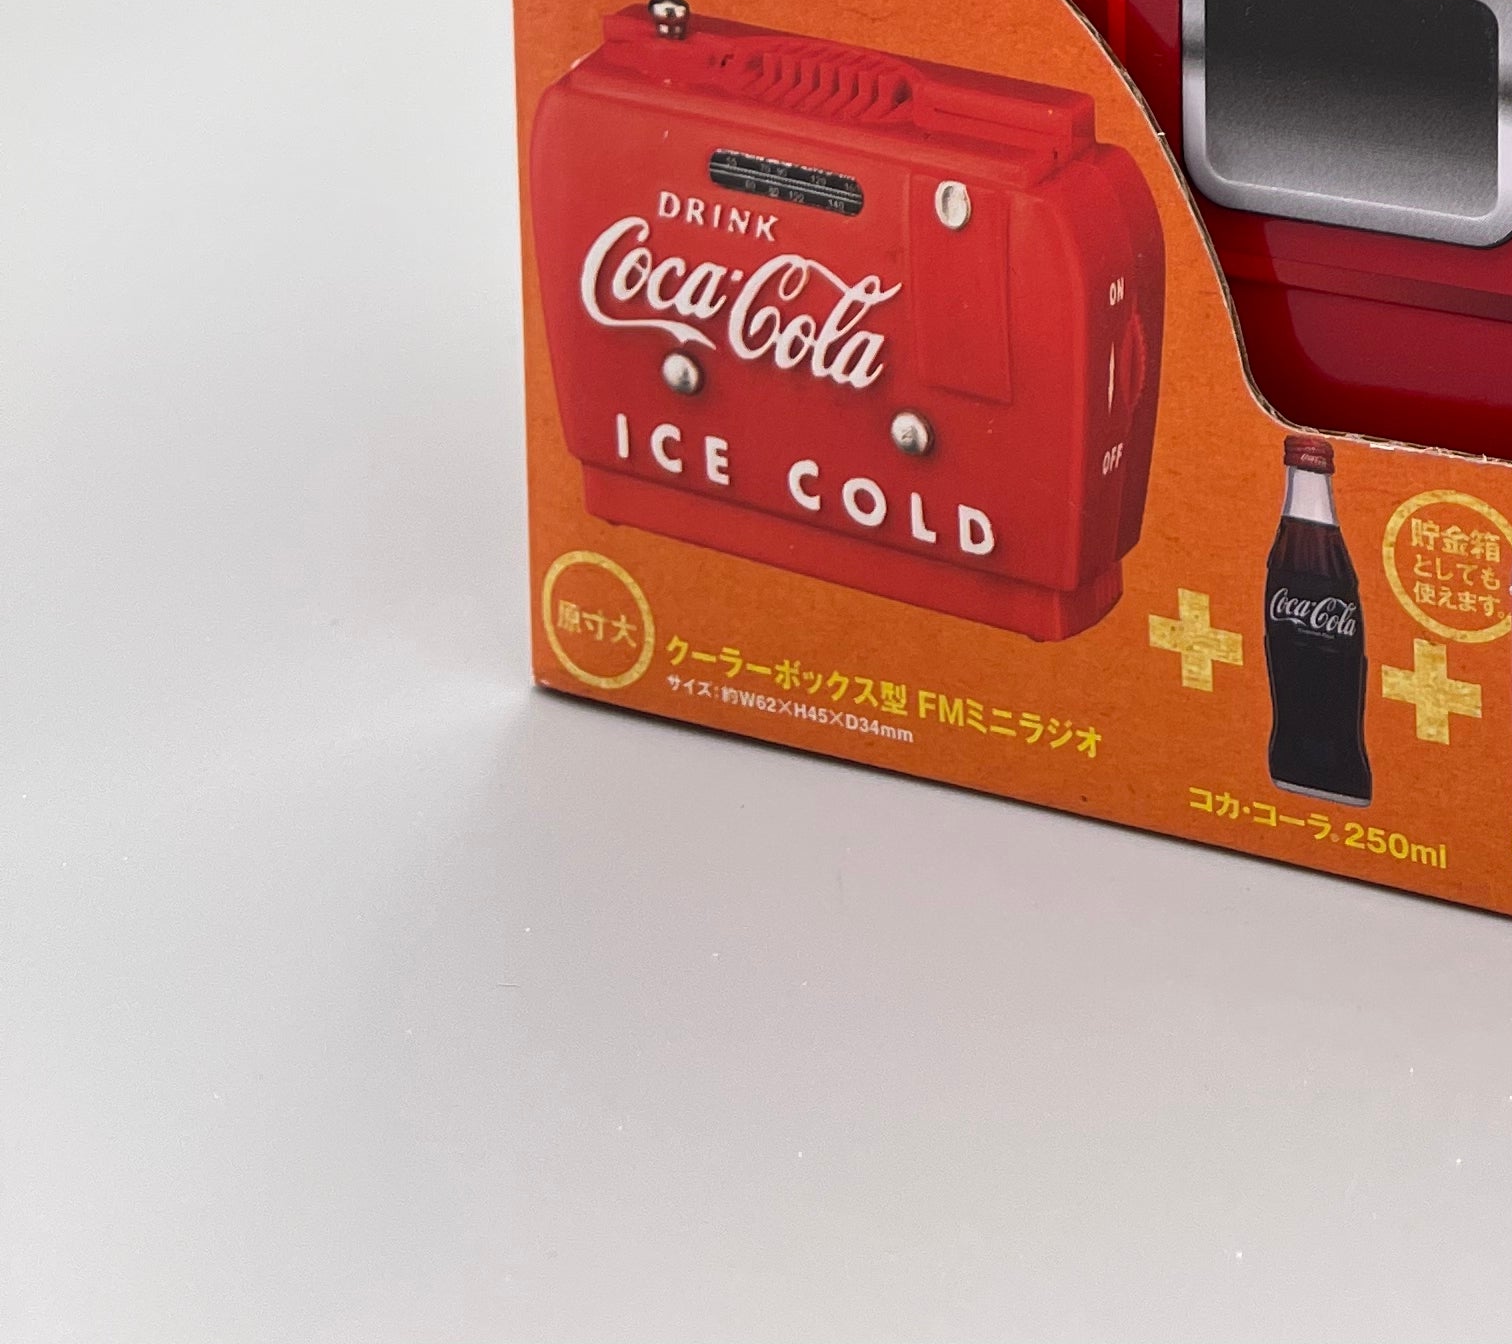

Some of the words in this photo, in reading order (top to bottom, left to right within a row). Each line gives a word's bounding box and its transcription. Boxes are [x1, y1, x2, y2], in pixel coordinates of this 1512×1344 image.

[658, 190, 778, 242] DRINK
[580, 217, 902, 389] Coca-Cola
[1109, 277, 1125, 306] ON
[615, 413, 731, 486] ICE
[1102, 442, 1124, 476] OFF
[788, 459, 996, 556] COLD
[1410, 517, 1501, 563] 貯金箱
[1413, 554, 1501, 591] としても
[557, 599, 638, 649] 原寸大
[1269, 587, 1358, 637] Coca-Cola
[1413, 581, 1506, 619] 使えます。
[666, 635, 908, 717] クーラーボックス型
[918, 689, 1102, 759] FMミニラジオ
